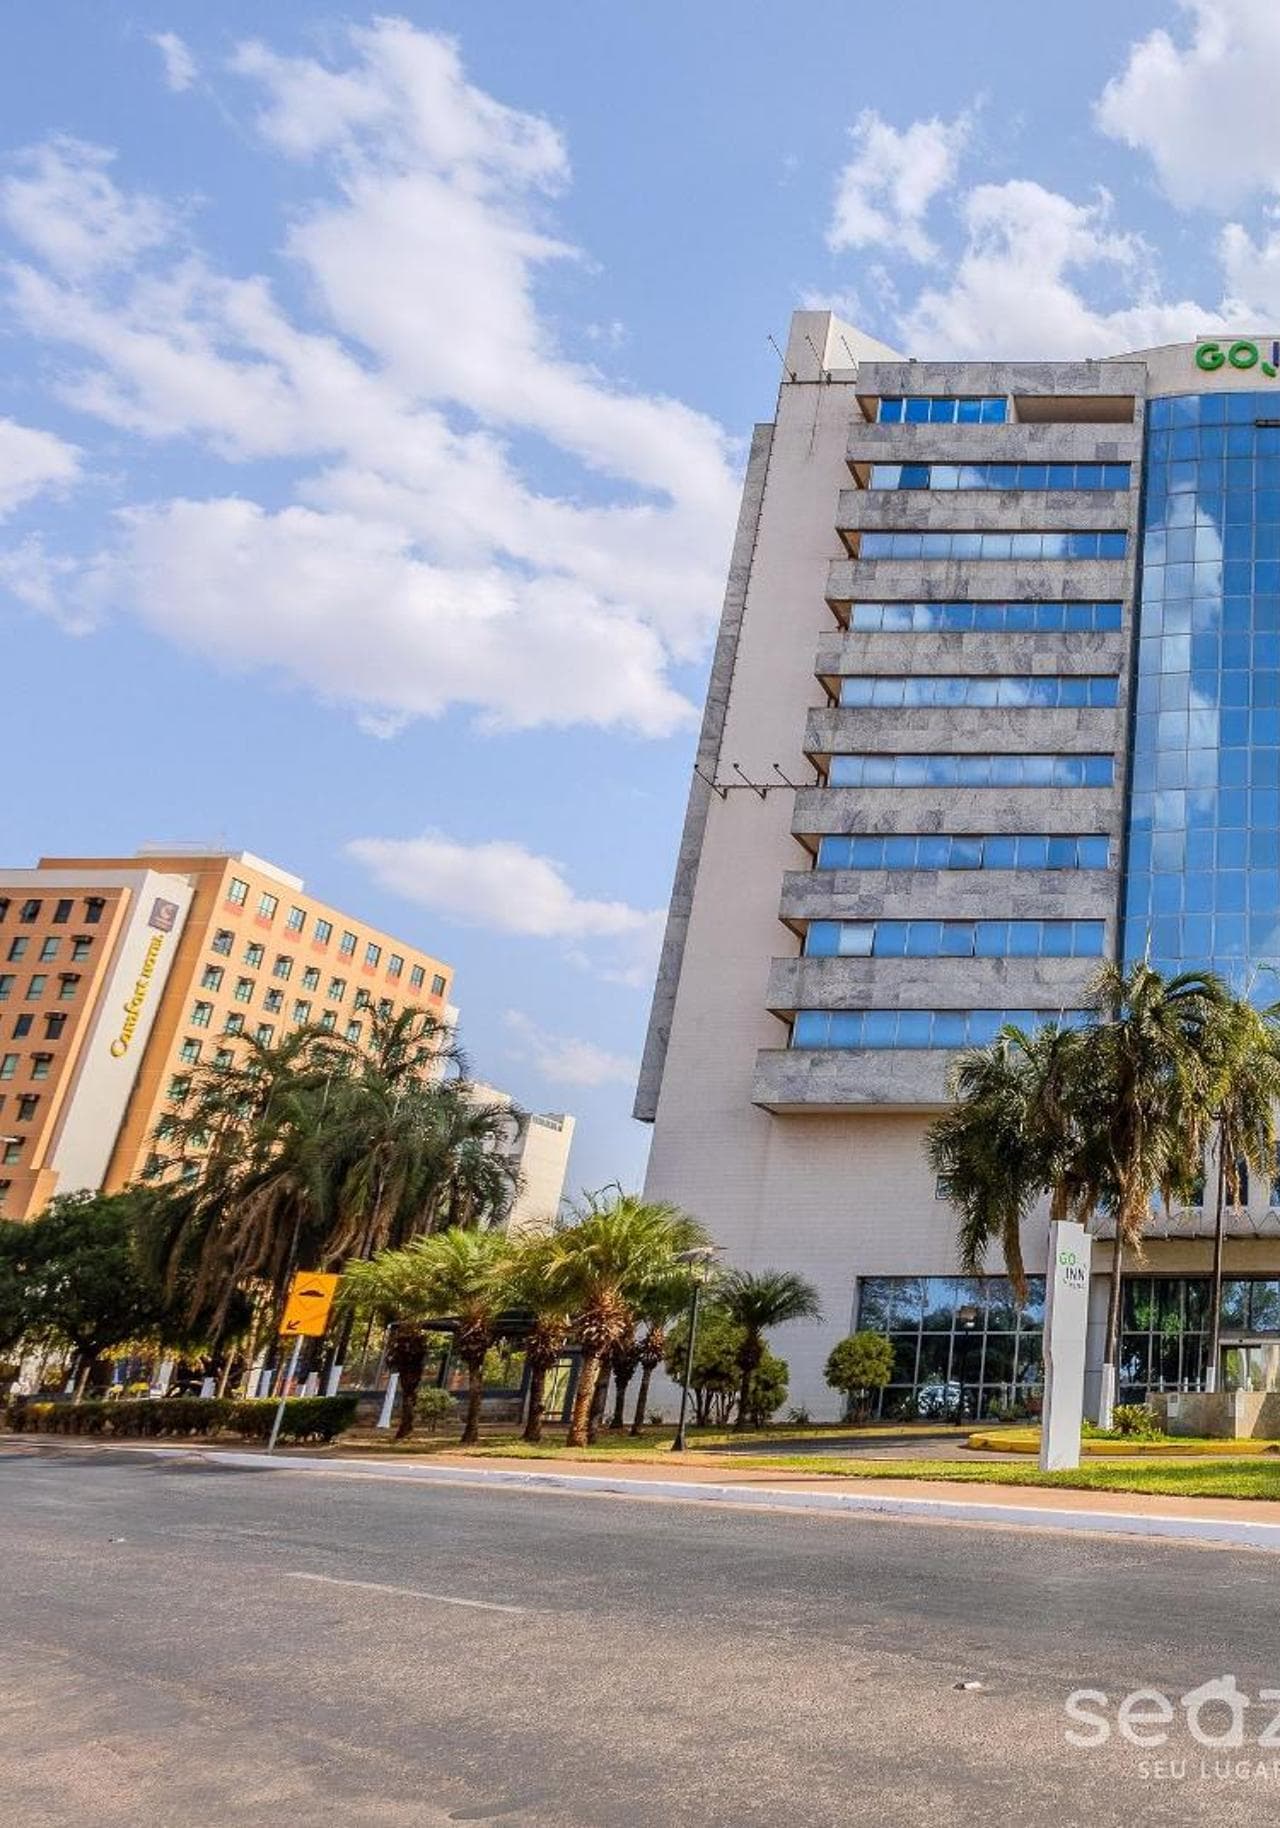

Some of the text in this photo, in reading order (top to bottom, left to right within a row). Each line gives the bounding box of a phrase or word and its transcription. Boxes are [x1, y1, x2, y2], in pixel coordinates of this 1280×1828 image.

[1196, 340, 1259, 371] GO
[1059, 1252, 1076, 1266] GO
[1066, 1267, 1085, 1281] INN
